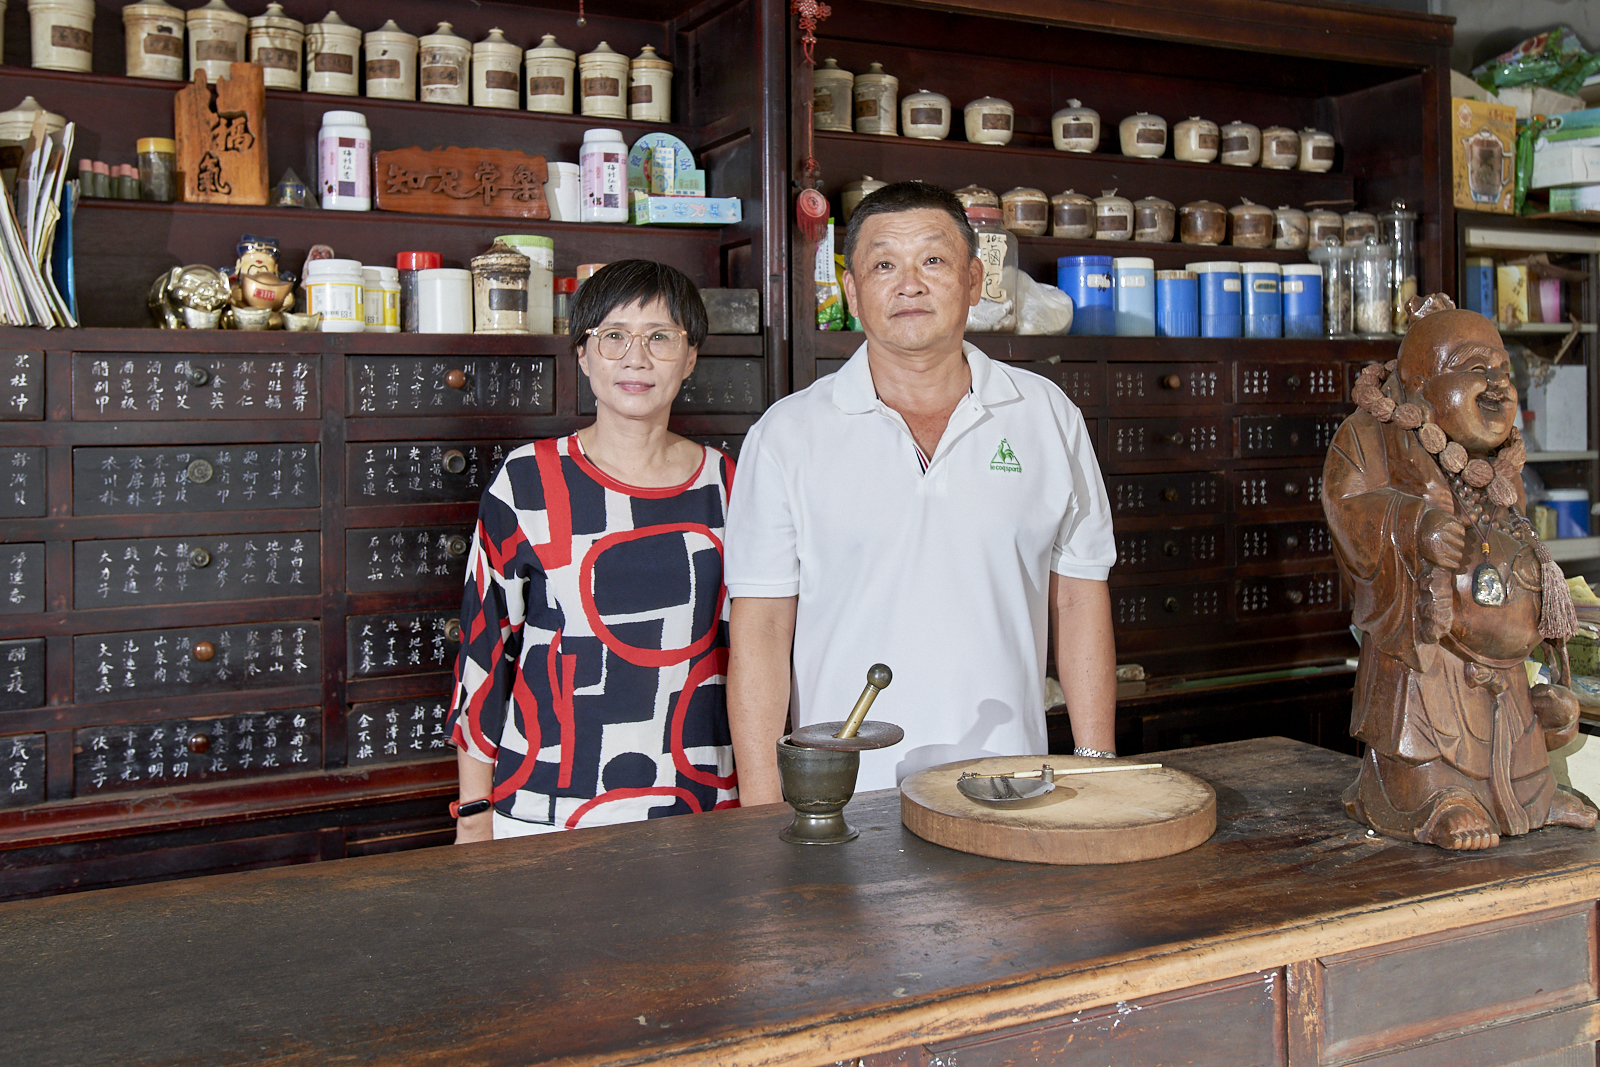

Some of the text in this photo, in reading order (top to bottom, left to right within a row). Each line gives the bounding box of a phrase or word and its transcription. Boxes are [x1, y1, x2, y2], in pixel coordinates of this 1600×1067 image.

[386, 160, 541, 206] 知足常樂
[210, 361, 226, 409] 小金英
[266, 539, 283, 584] 地骨皮
